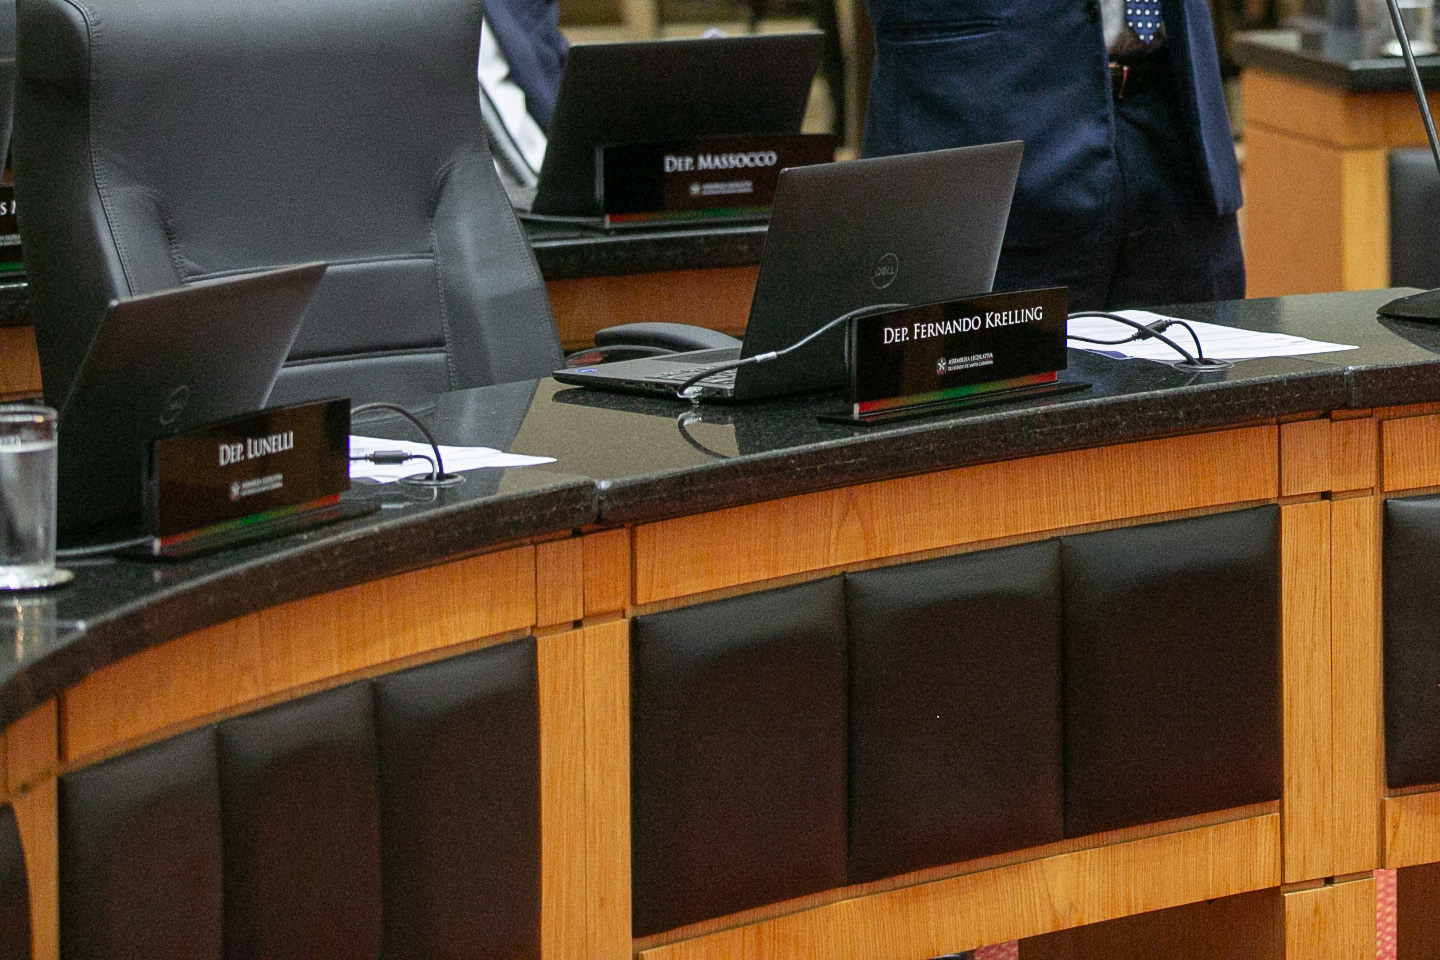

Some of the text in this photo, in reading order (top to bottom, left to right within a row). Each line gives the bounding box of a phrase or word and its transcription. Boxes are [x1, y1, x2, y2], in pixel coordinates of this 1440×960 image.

[664, 150, 777, 172] DEP. MASSOCCO
[883, 306, 1043, 344] DEP. FERNANDO KRELLING
[219, 430, 294, 466] DEP. LUNELLI
